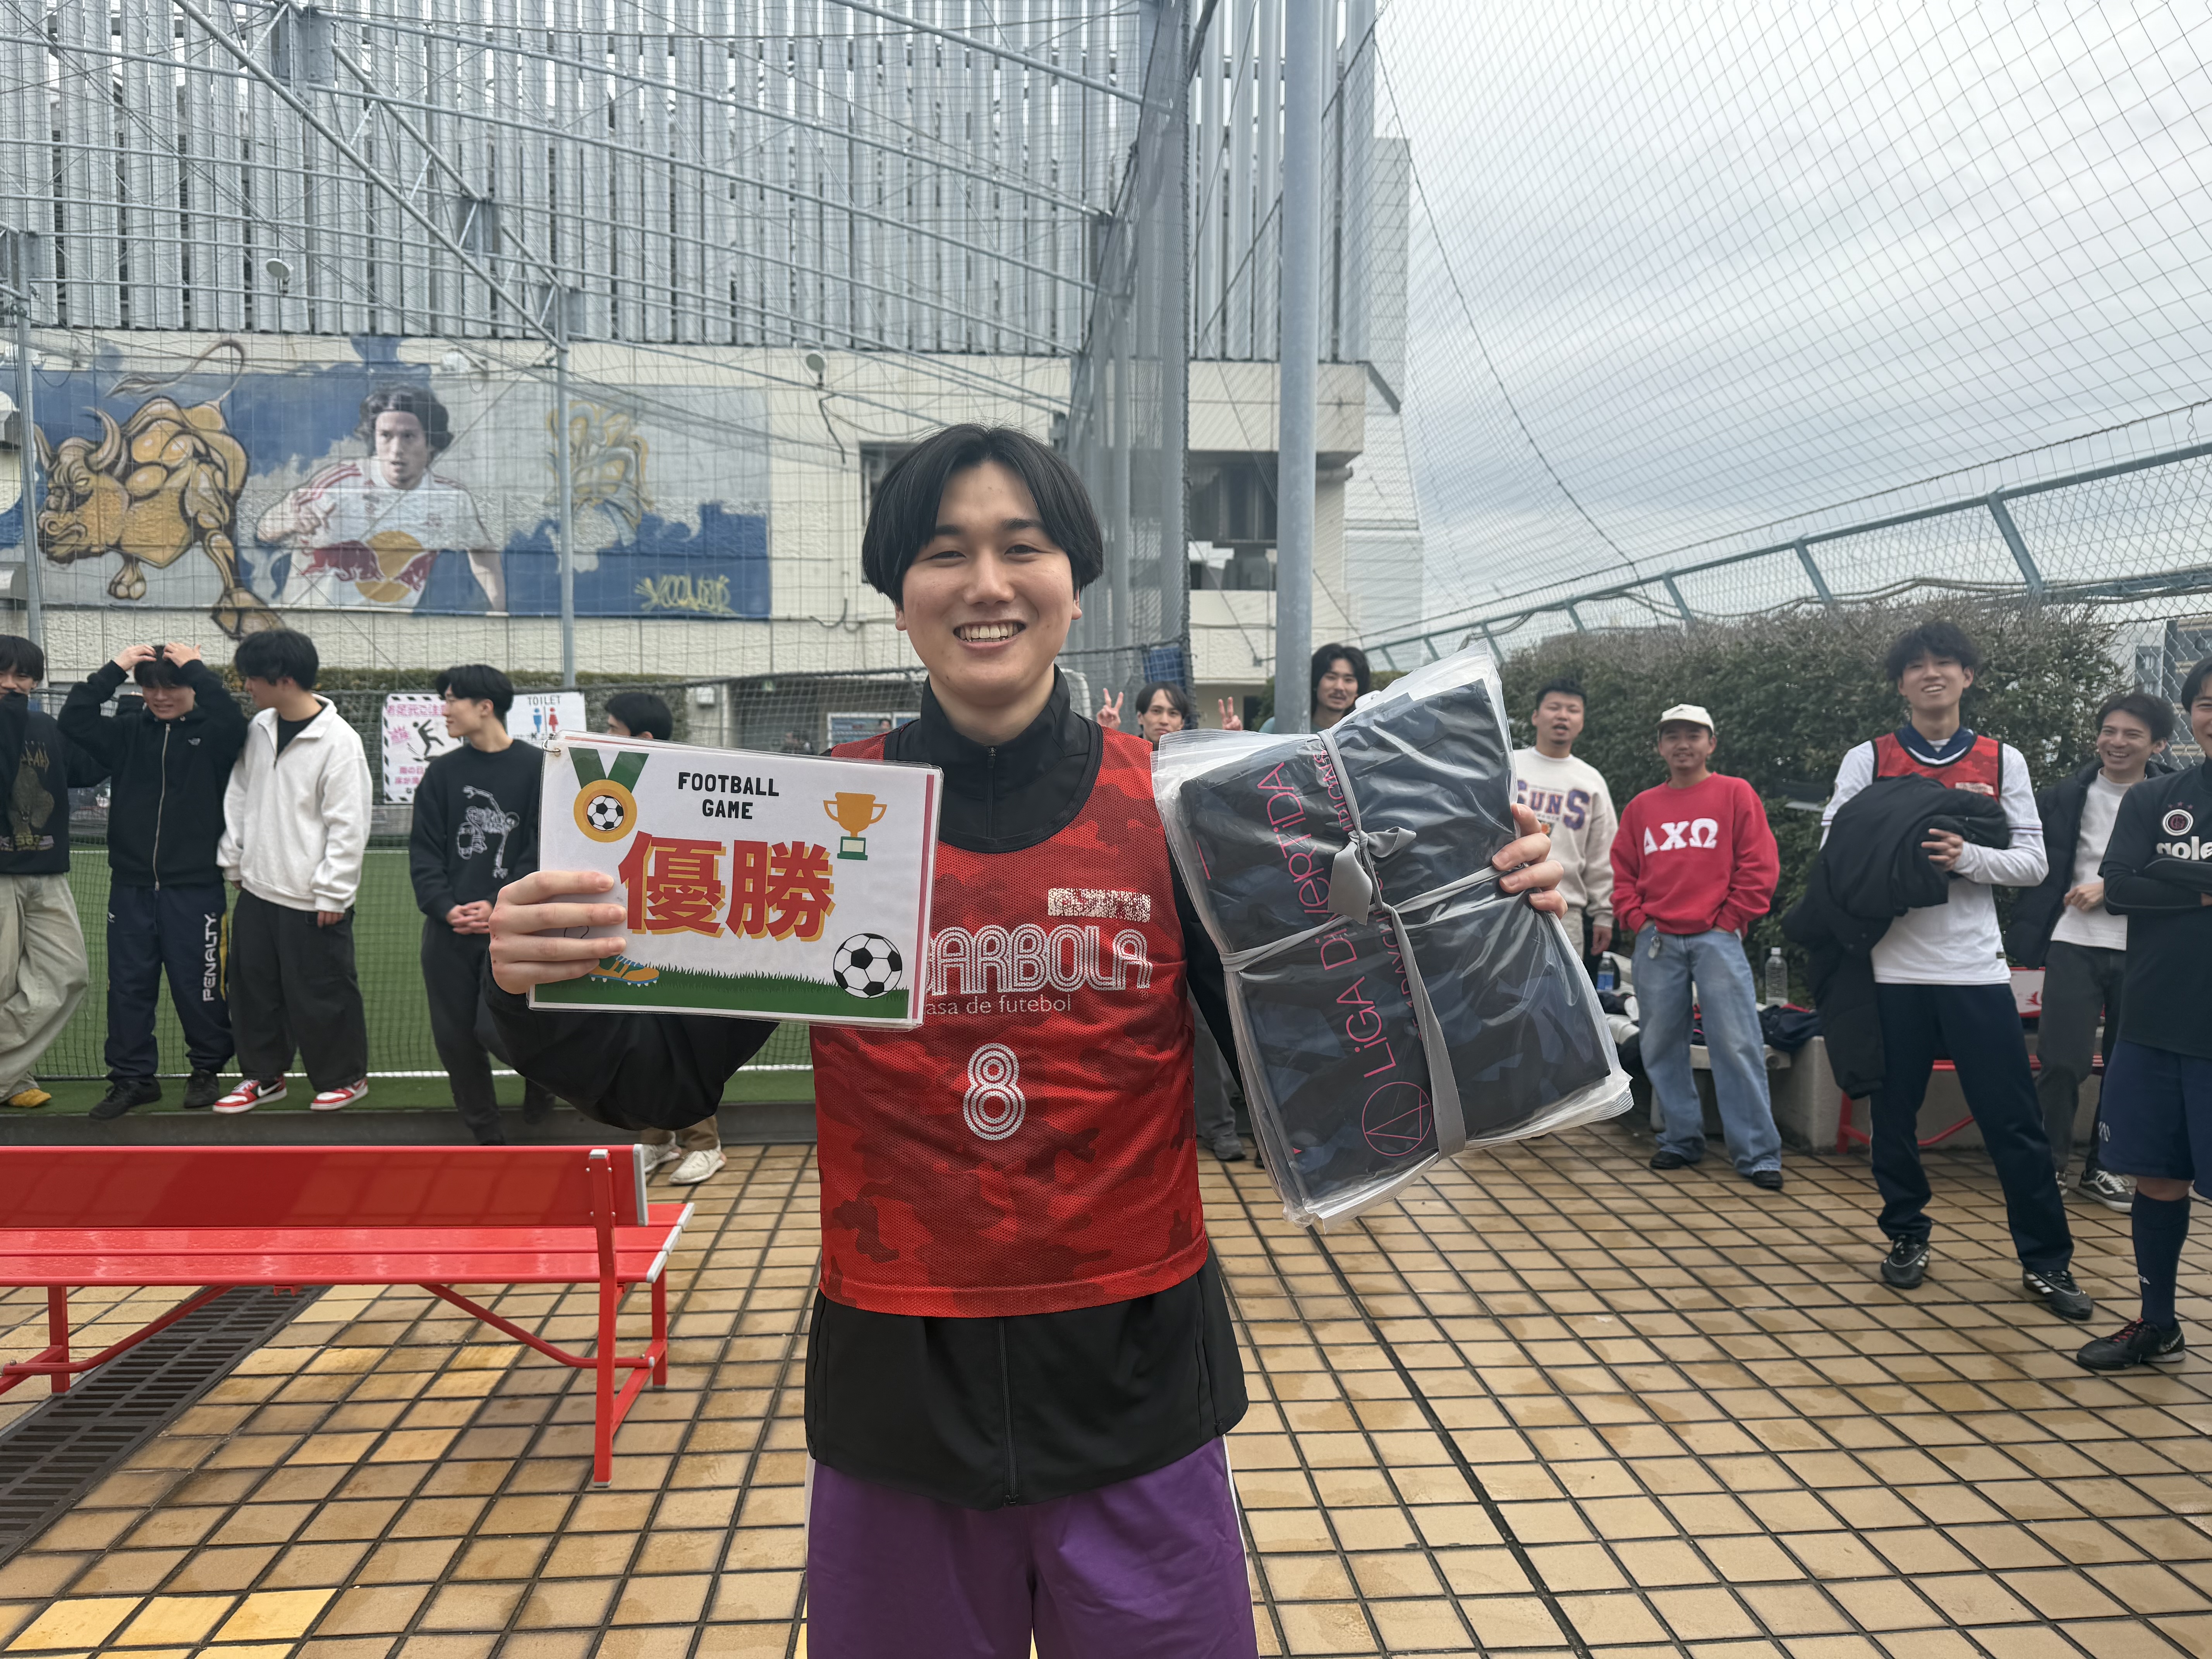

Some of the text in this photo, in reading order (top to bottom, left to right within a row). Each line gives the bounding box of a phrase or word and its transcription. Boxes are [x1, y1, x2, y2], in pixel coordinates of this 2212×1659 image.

[527, 695, 561, 706] TOILET
[678, 772, 779, 797] FOOTBALL
[702, 799, 753, 819] GAME
[618, 831, 836, 942] 優勝
[203, 914, 218, 1001] PENALTY
[927, 923, 1153, 996] ARBOLA
[926, 994, 1071, 1015] asa de futebol
[963, 1042, 1026, 1140] 8
